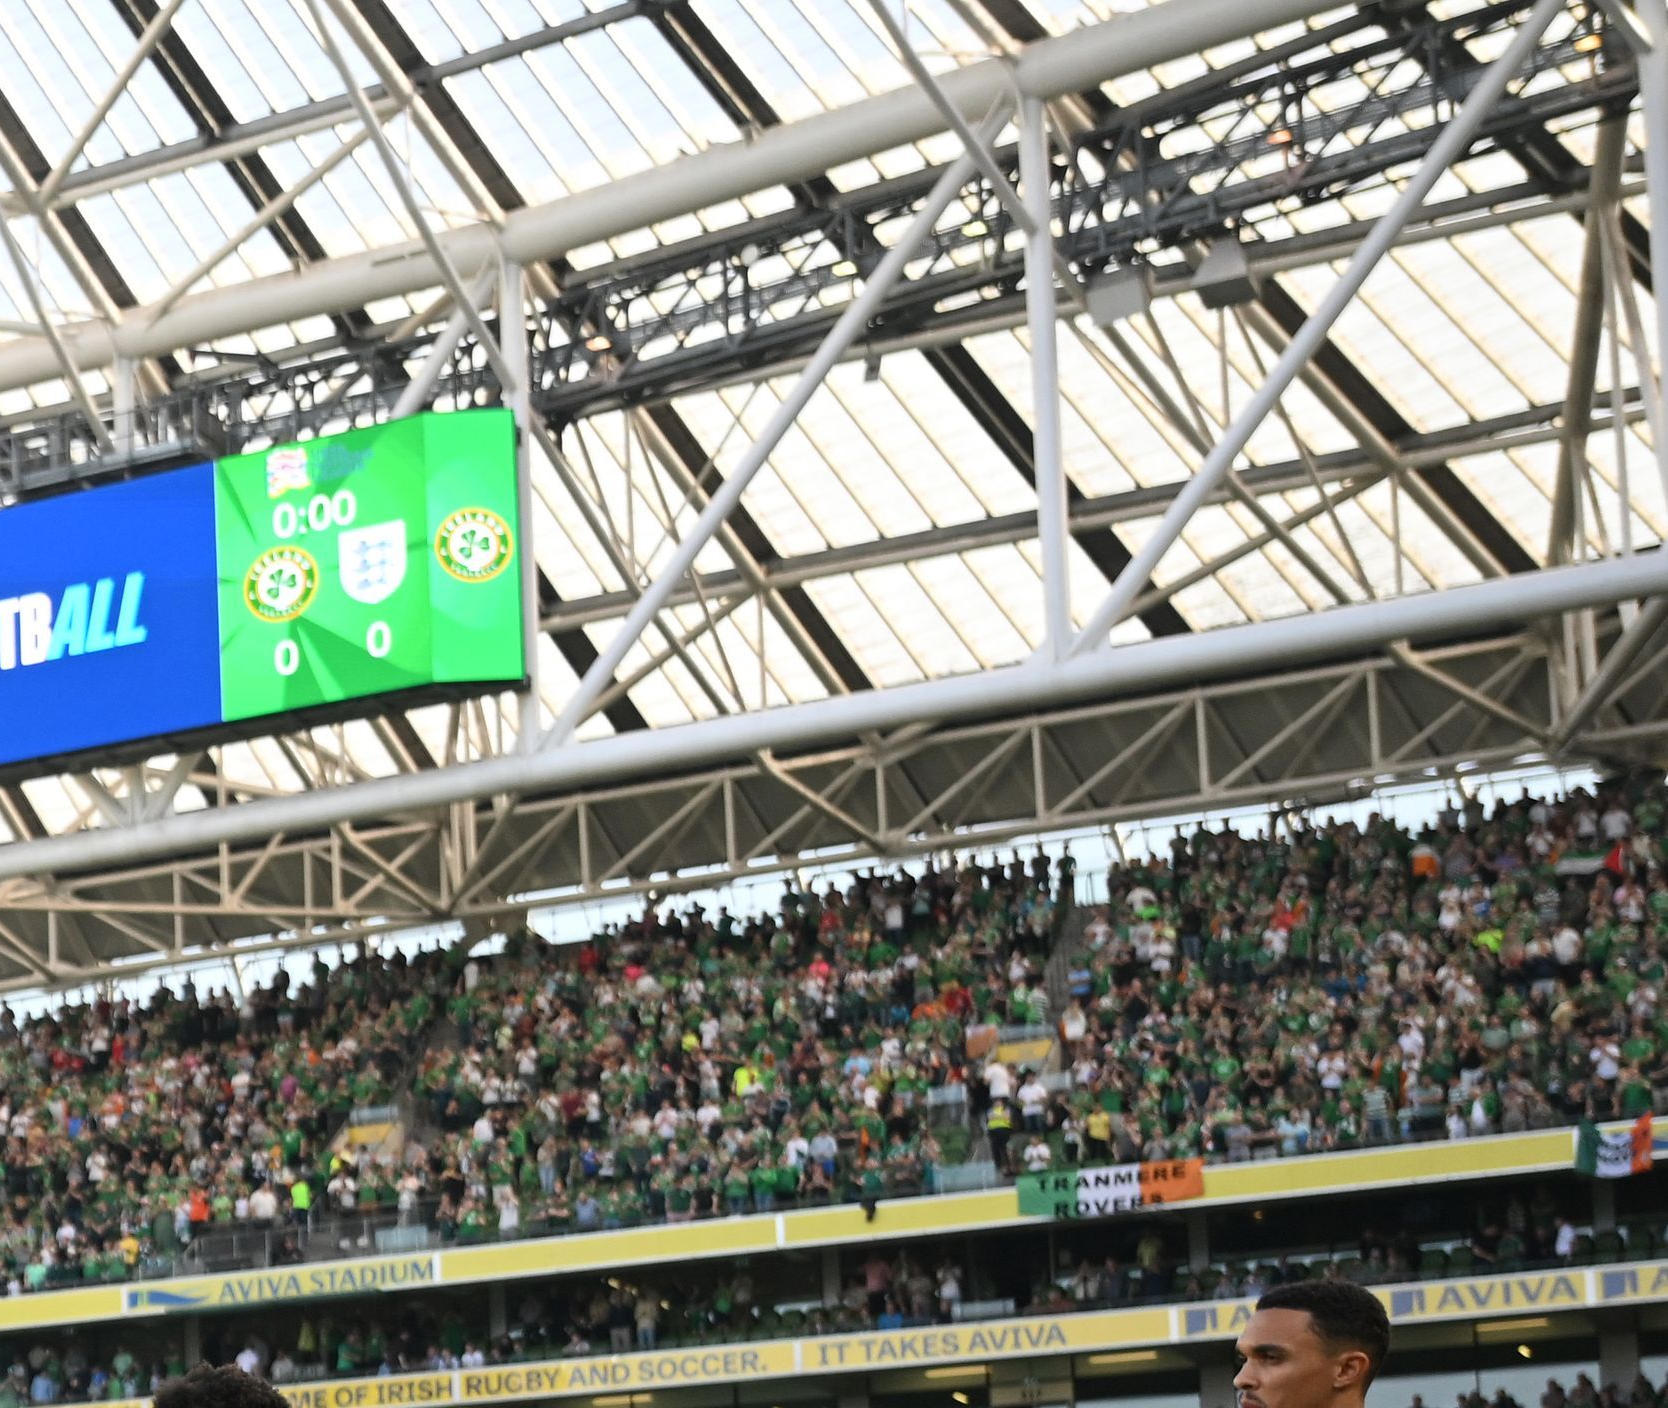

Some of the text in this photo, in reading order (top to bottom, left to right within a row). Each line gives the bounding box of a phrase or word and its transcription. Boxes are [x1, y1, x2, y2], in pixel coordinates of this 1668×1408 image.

[272, 489, 357, 539] 0:00
[274, 639, 300, 676] 0
[365, 621, 392, 658] 0
[1039, 1163, 1185, 1192] TRANMERE
[219, 1259, 434, 1303] AVIVA STADIUM
[1435, 1277, 1578, 1312] AVIVA
[818, 1323, 1066, 1366] IT TAKES AVIVA
[332, 1386, 368, 1408] OF
[378, 1380, 454, 1404] IRISH
[465, 1367, 560, 1397] RUGBY
[569, 1360, 631, 1387] AND
